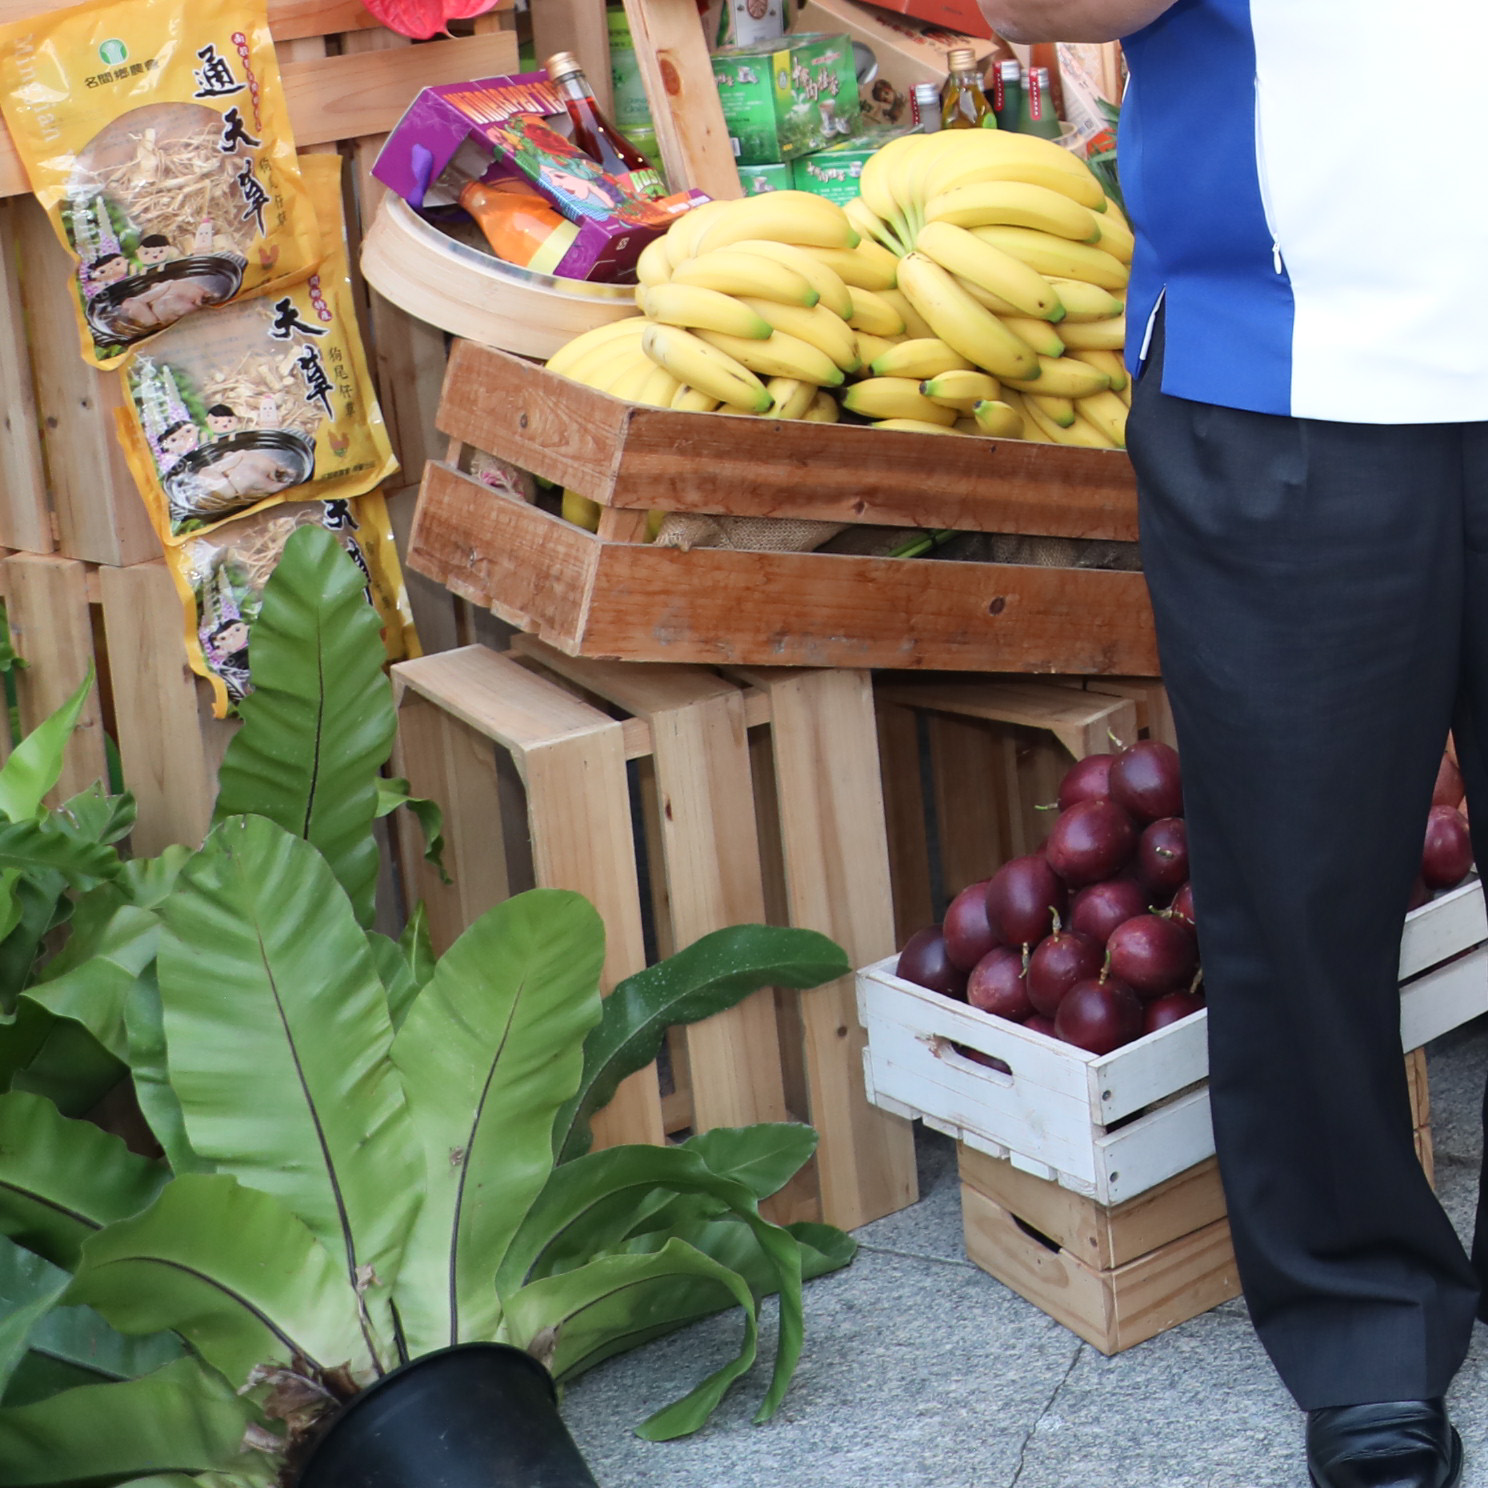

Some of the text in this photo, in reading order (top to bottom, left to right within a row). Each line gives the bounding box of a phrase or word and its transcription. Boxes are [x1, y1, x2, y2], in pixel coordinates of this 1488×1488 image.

[84, 59, 160, 90] 名間鄉農會
[193, 43, 271, 238] 通天草
